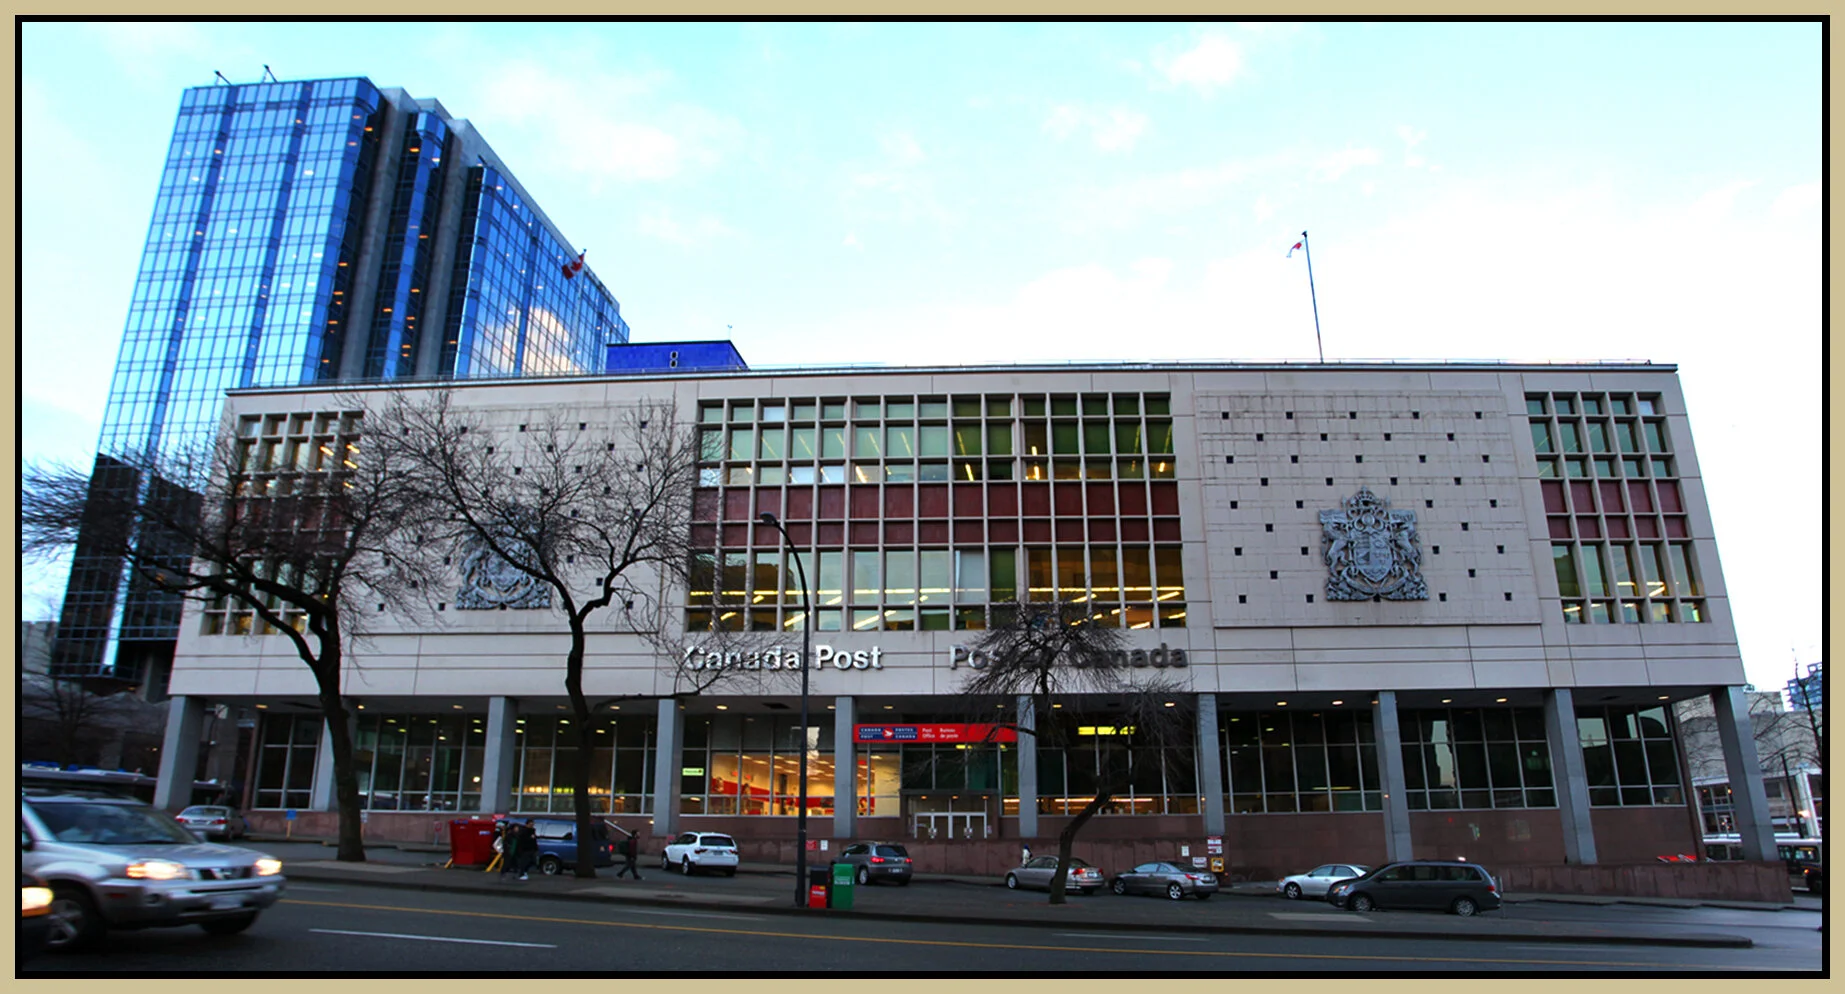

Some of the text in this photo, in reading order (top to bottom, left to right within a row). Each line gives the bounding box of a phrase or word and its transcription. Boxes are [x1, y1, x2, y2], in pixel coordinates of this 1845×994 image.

[684, 645, 883, 671] Canada Post
[949, 644, 1056, 670] Pose
